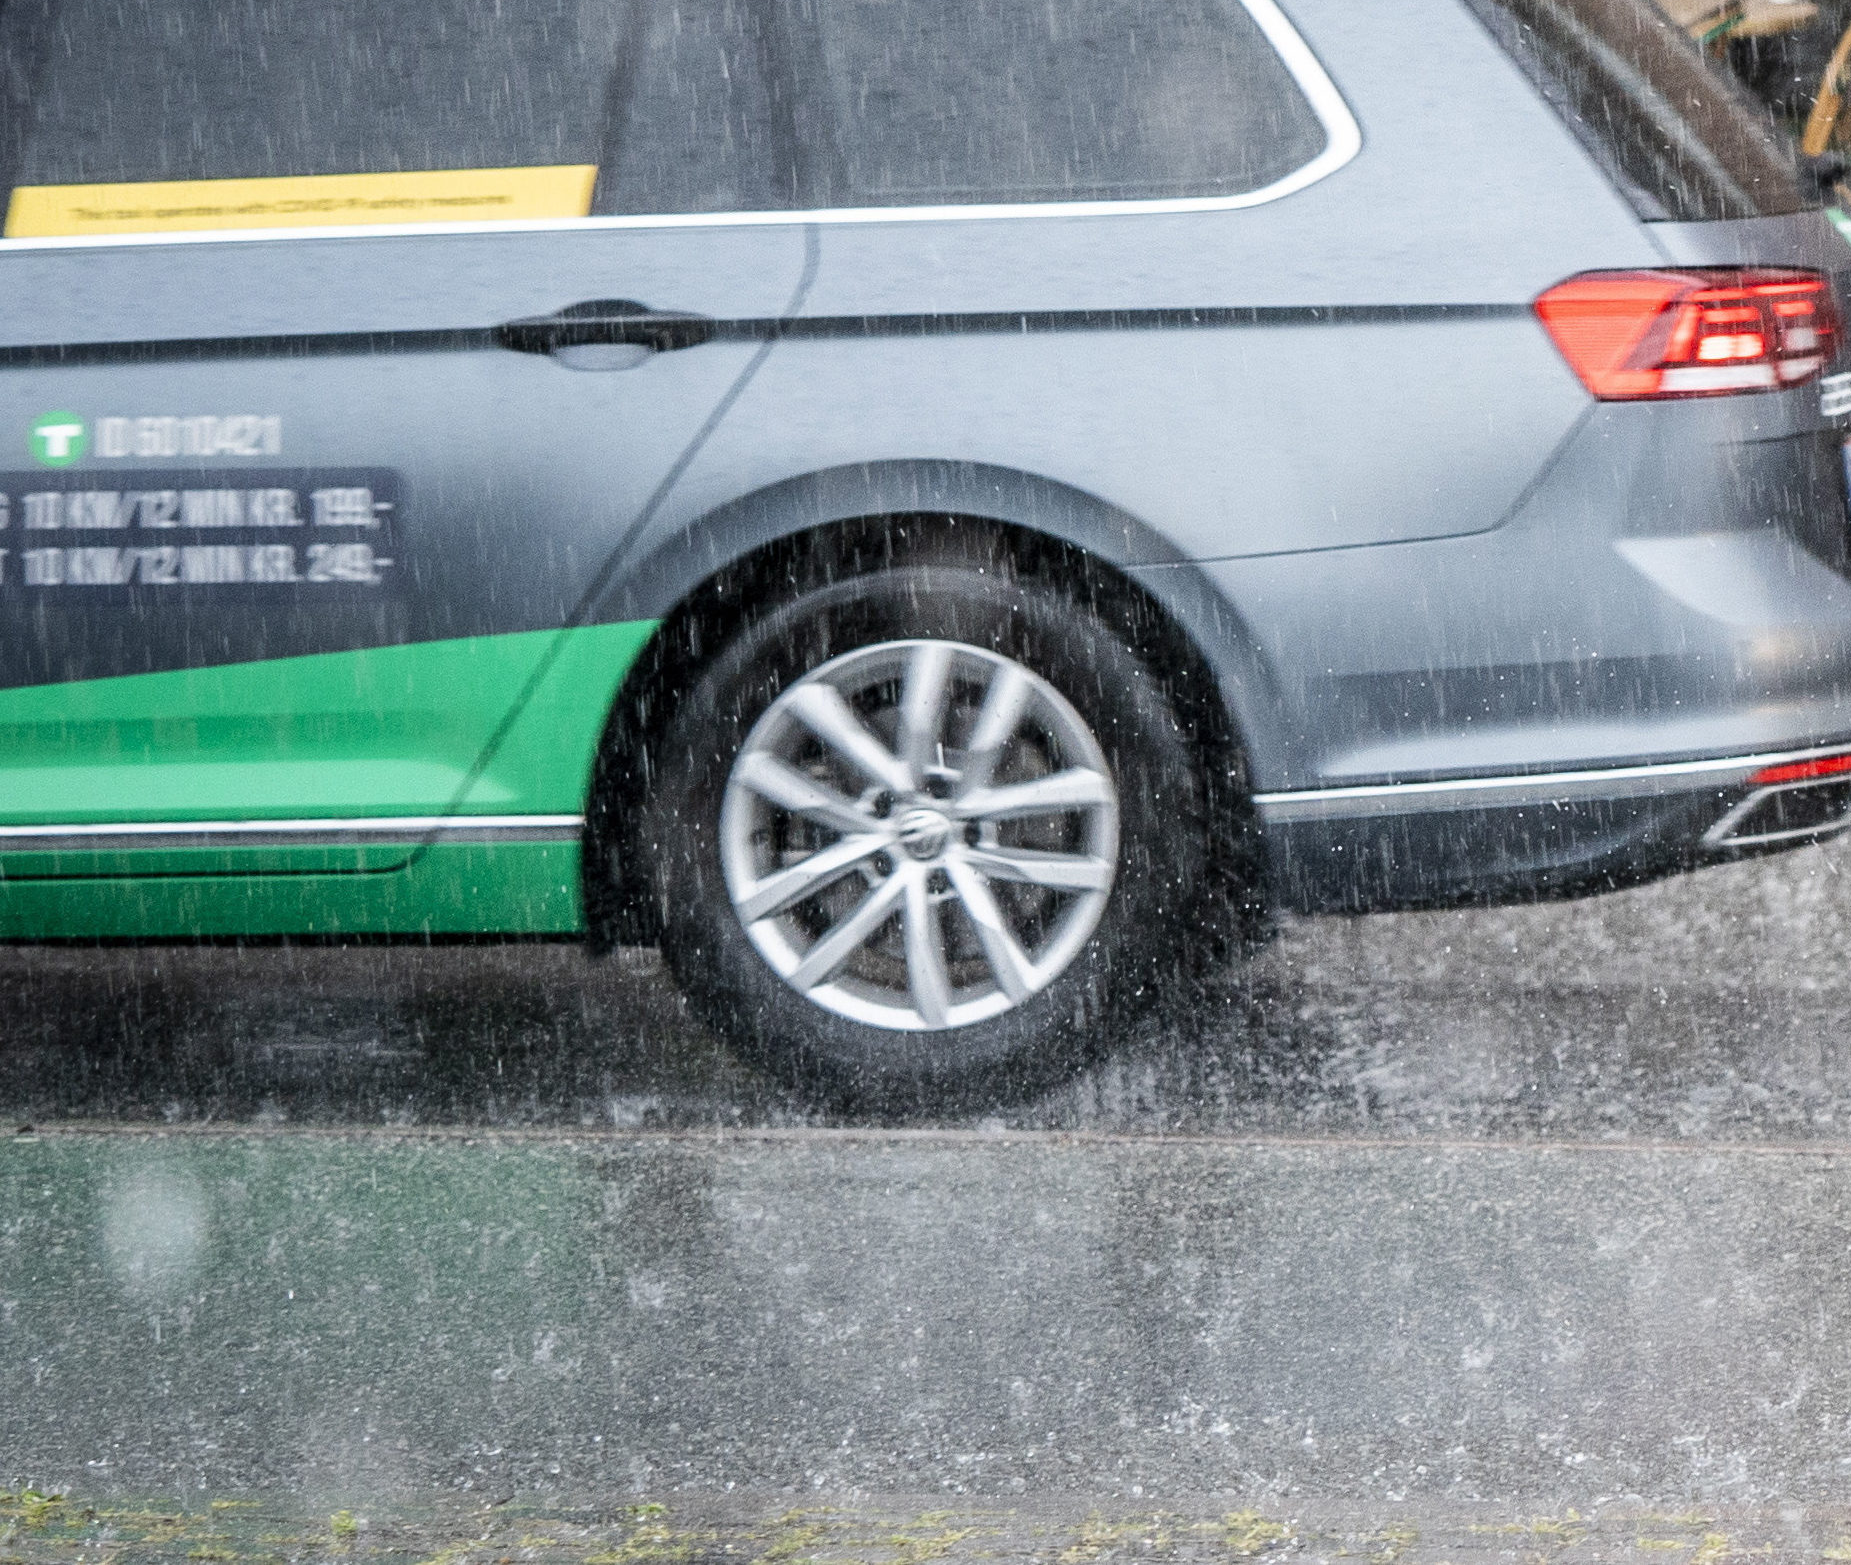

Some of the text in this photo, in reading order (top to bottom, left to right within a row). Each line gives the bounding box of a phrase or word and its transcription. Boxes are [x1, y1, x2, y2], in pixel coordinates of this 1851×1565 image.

[96, 416, 131, 458] ID
[23, 490, 64, 530] 10
[182, 489, 244, 529] MIN
[23, 546, 64, 586] 10
[182, 545, 244, 585] MIN
